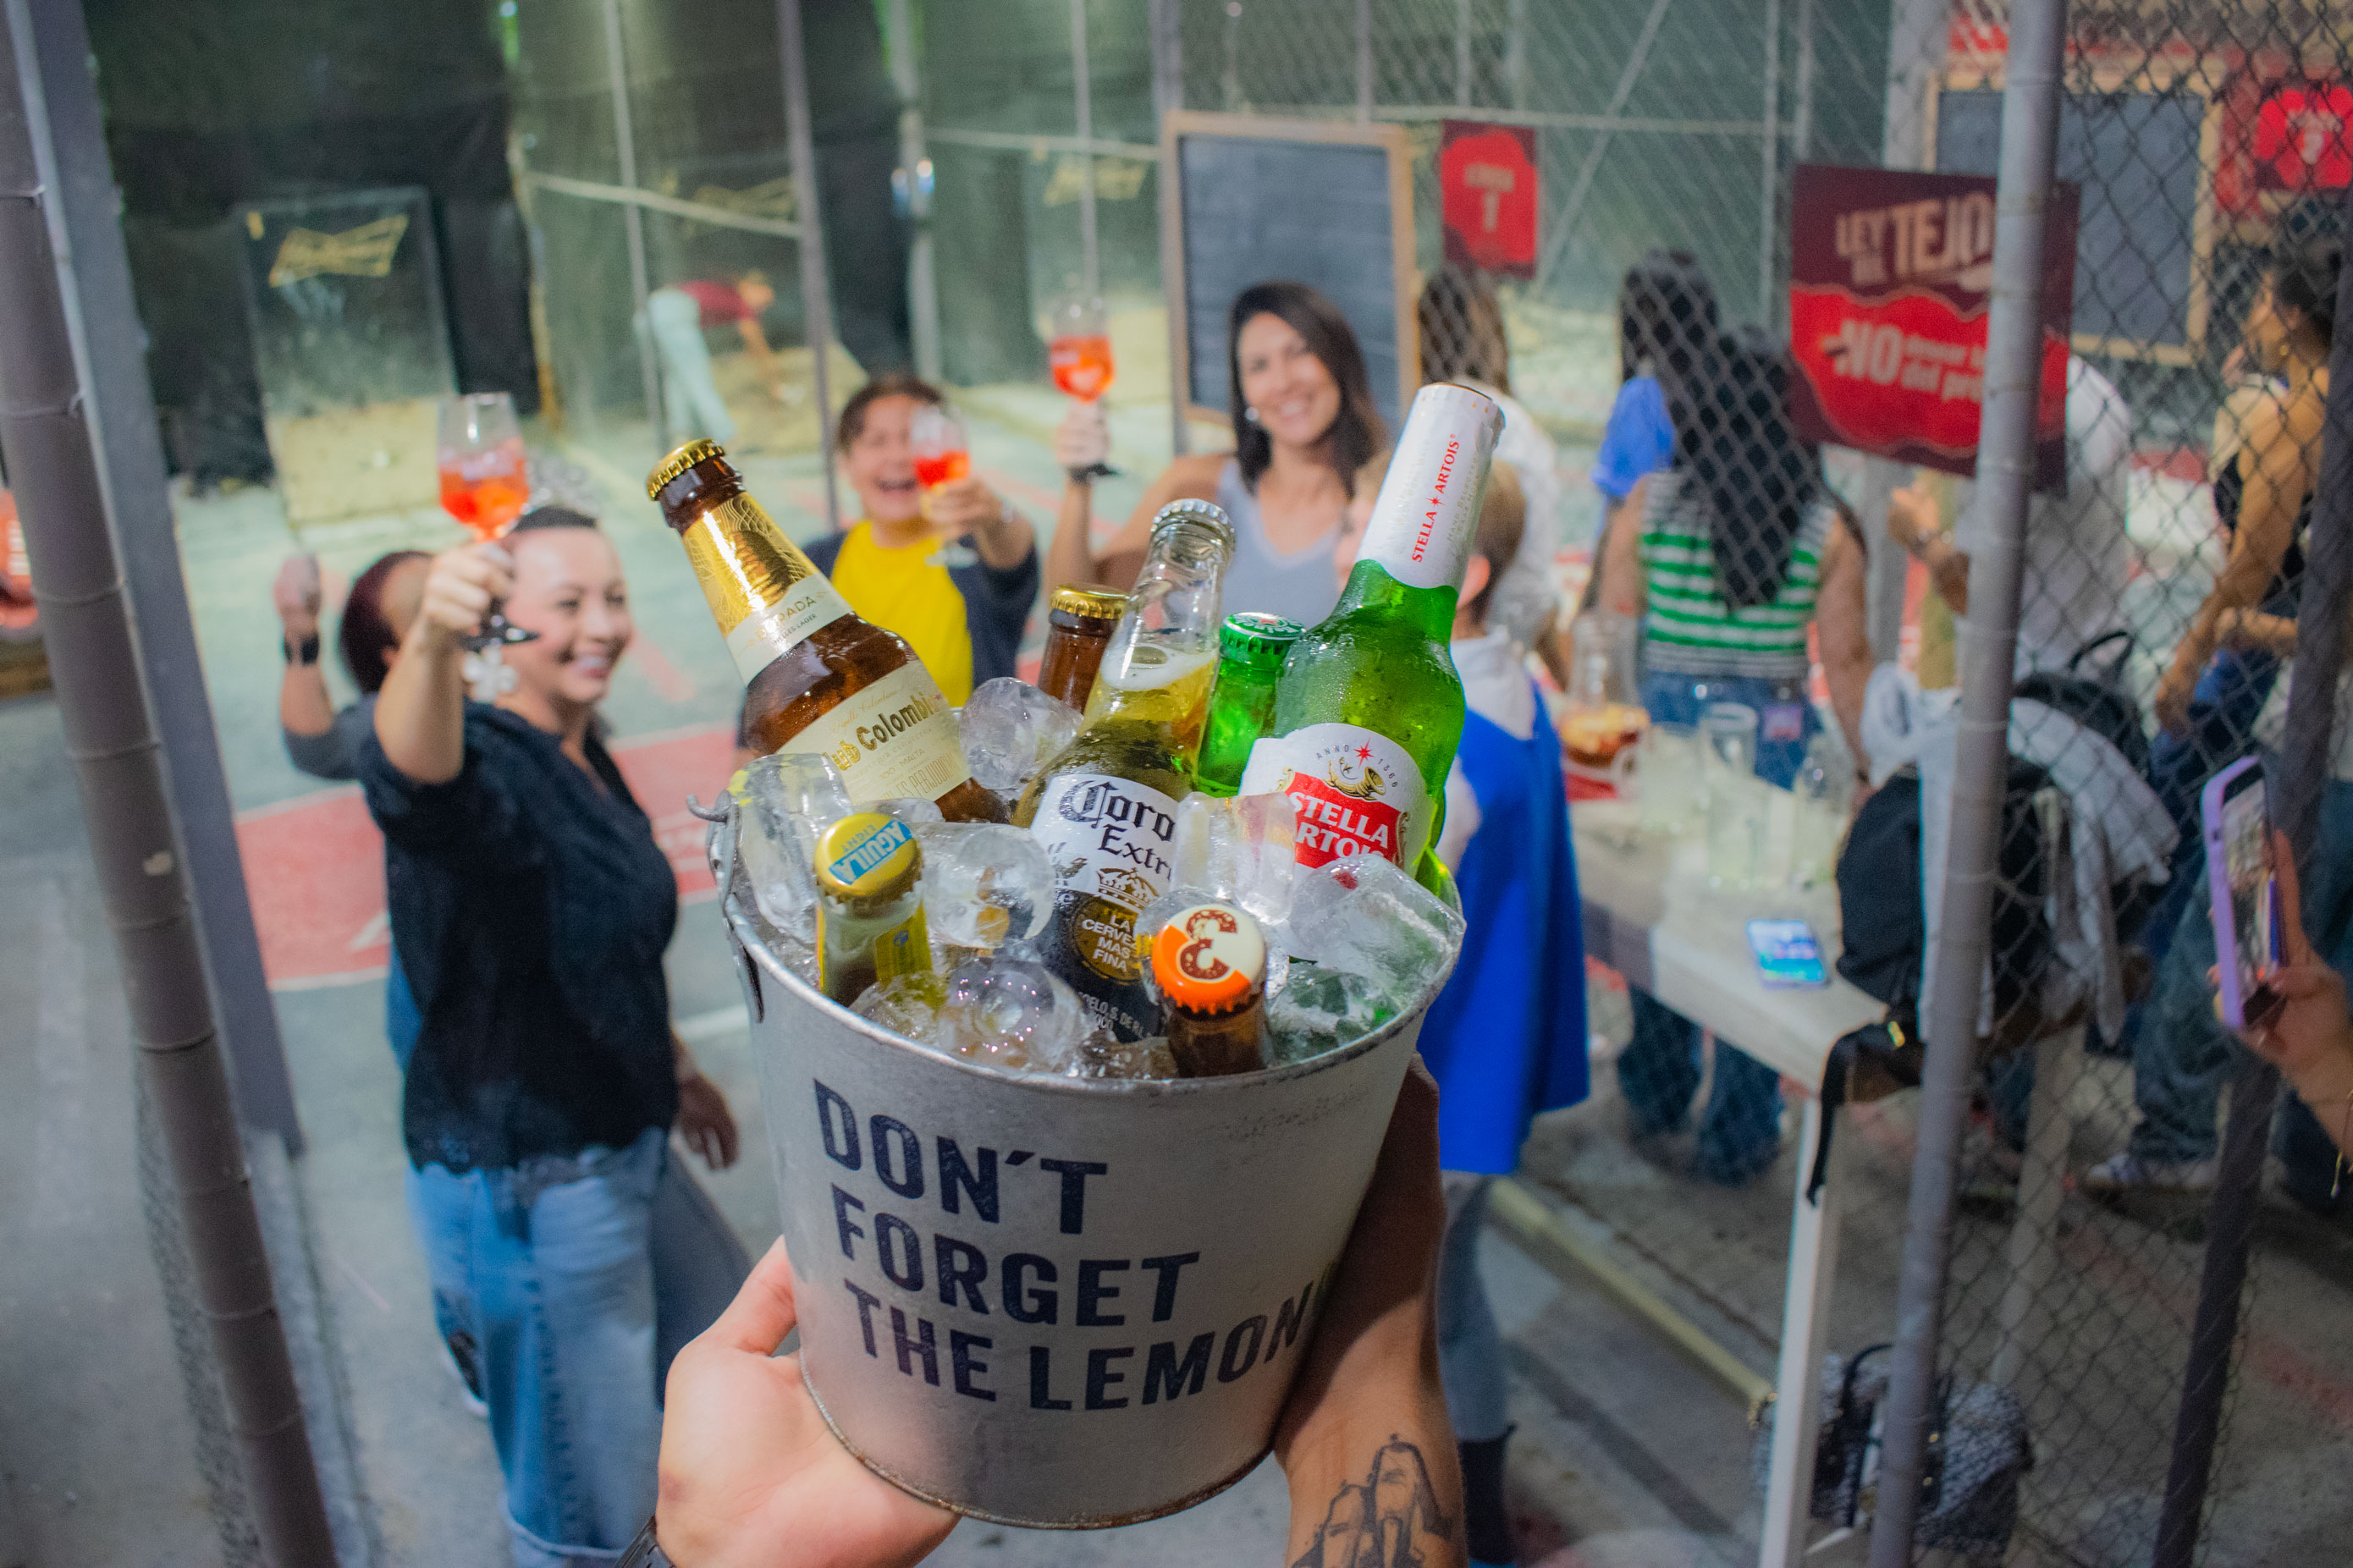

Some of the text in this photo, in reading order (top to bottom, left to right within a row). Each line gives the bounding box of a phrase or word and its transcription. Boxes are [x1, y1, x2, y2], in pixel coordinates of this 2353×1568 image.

[1890, 192, 1992, 275] TEJO
[1833, 319, 1904, 386] NO
[1411, 510, 1437, 563] STELLA
[1435, 439, 1460, 494] ARTOIS
[754, 594, 818, 641] DRADA
[899, 748, 925, 767] MALTA
[1315, 744, 1350, 760] ANNO
[1377, 758, 1399, 789] 1366
[1060, 780, 1176, 841] Coro
[1288, 791, 1389, 850] STELLA
[835, 818, 908, 883] AGUILA
[1098, 823, 1172, 882] Extr
[1295, 822, 1386, 860] RTO
[1096, 936, 1132, 960] MAS
[1109, 914, 1131, 933] LA
[1092, 948, 1128, 973] FINA
[831, 1183, 1200, 1327] FORGET
[845, 1278, 1315, 1411] THE LEMON
